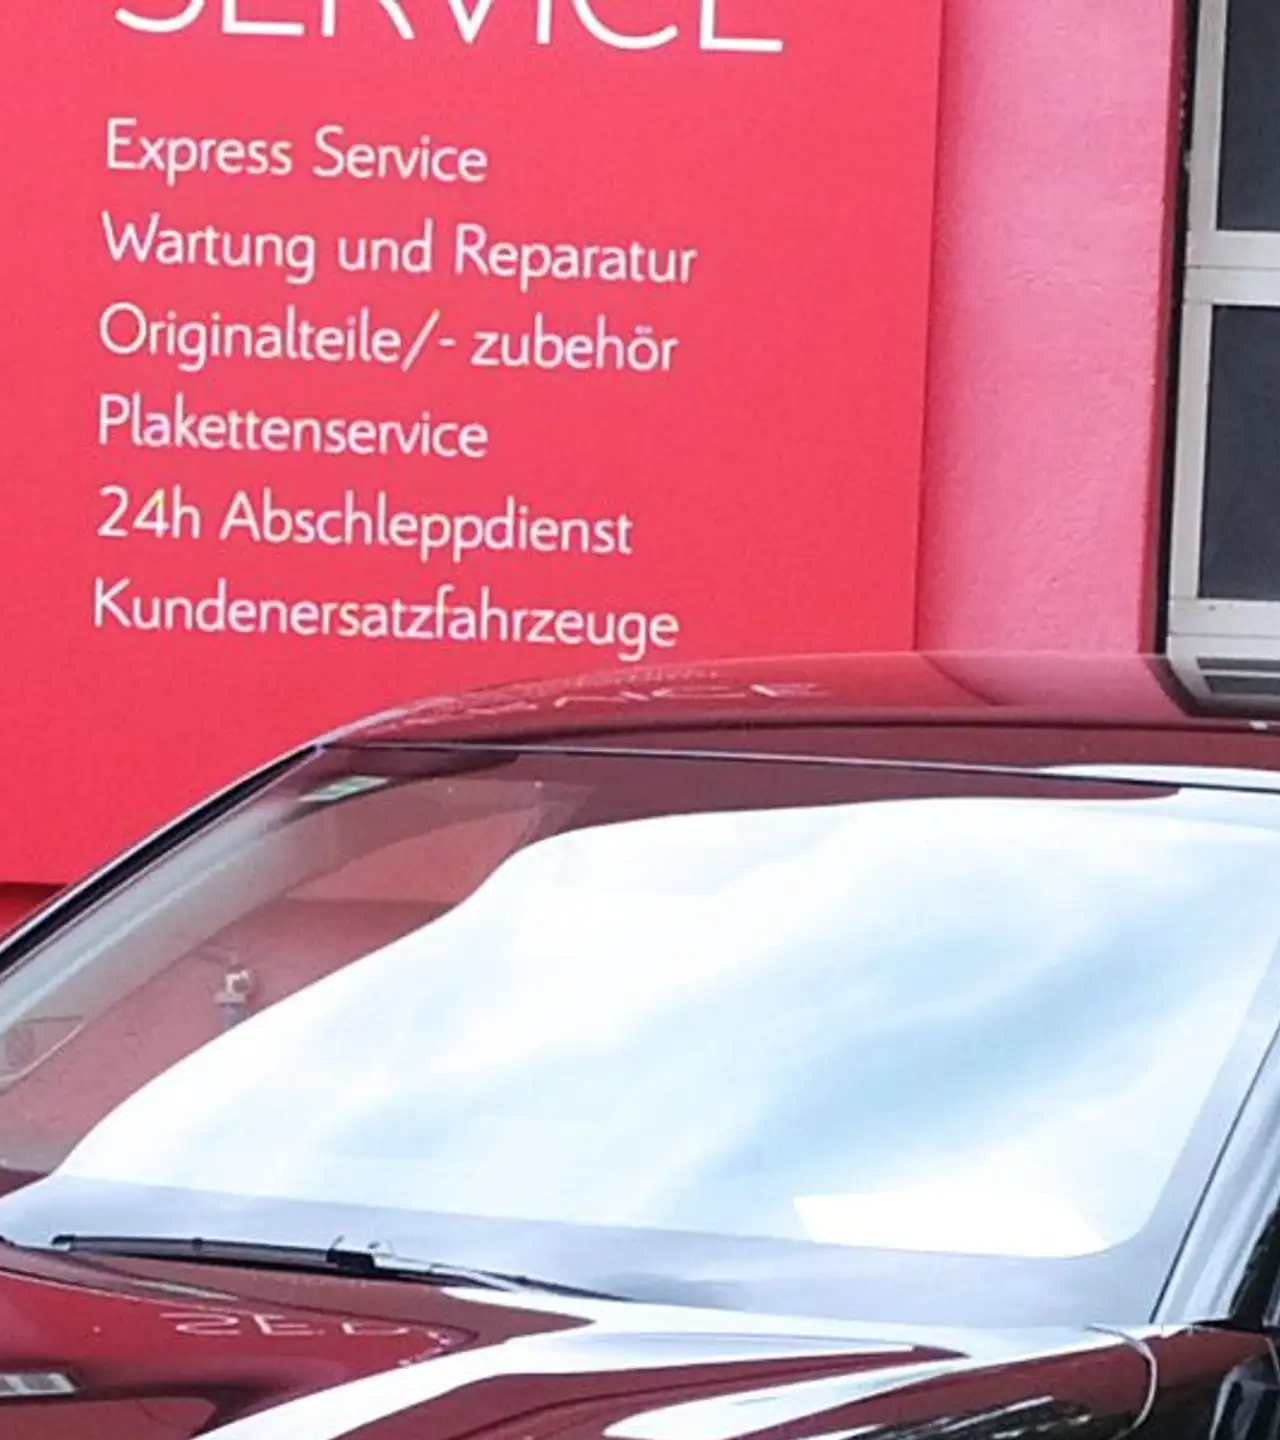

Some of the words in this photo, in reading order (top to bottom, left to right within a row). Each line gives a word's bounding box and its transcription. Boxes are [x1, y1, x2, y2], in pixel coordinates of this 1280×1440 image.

[107, 117, 292, 186] Express
[313, 125, 488, 182] Service
[102, 210, 315, 285] Wartung
[338, 218, 433, 273] und
[455, 223, 697, 292] Reparatur
[100, 302, 454, 372] Originalteile/-
[471, 313, 678, 371] zubehör
[99, 392, 488, 458] Plakettenservice
[98, 485, 200, 540] 24h
[220, 487, 632, 562] Abschleppdienst
[95, 577, 679, 662] Kundenersatzfahrzeuge
